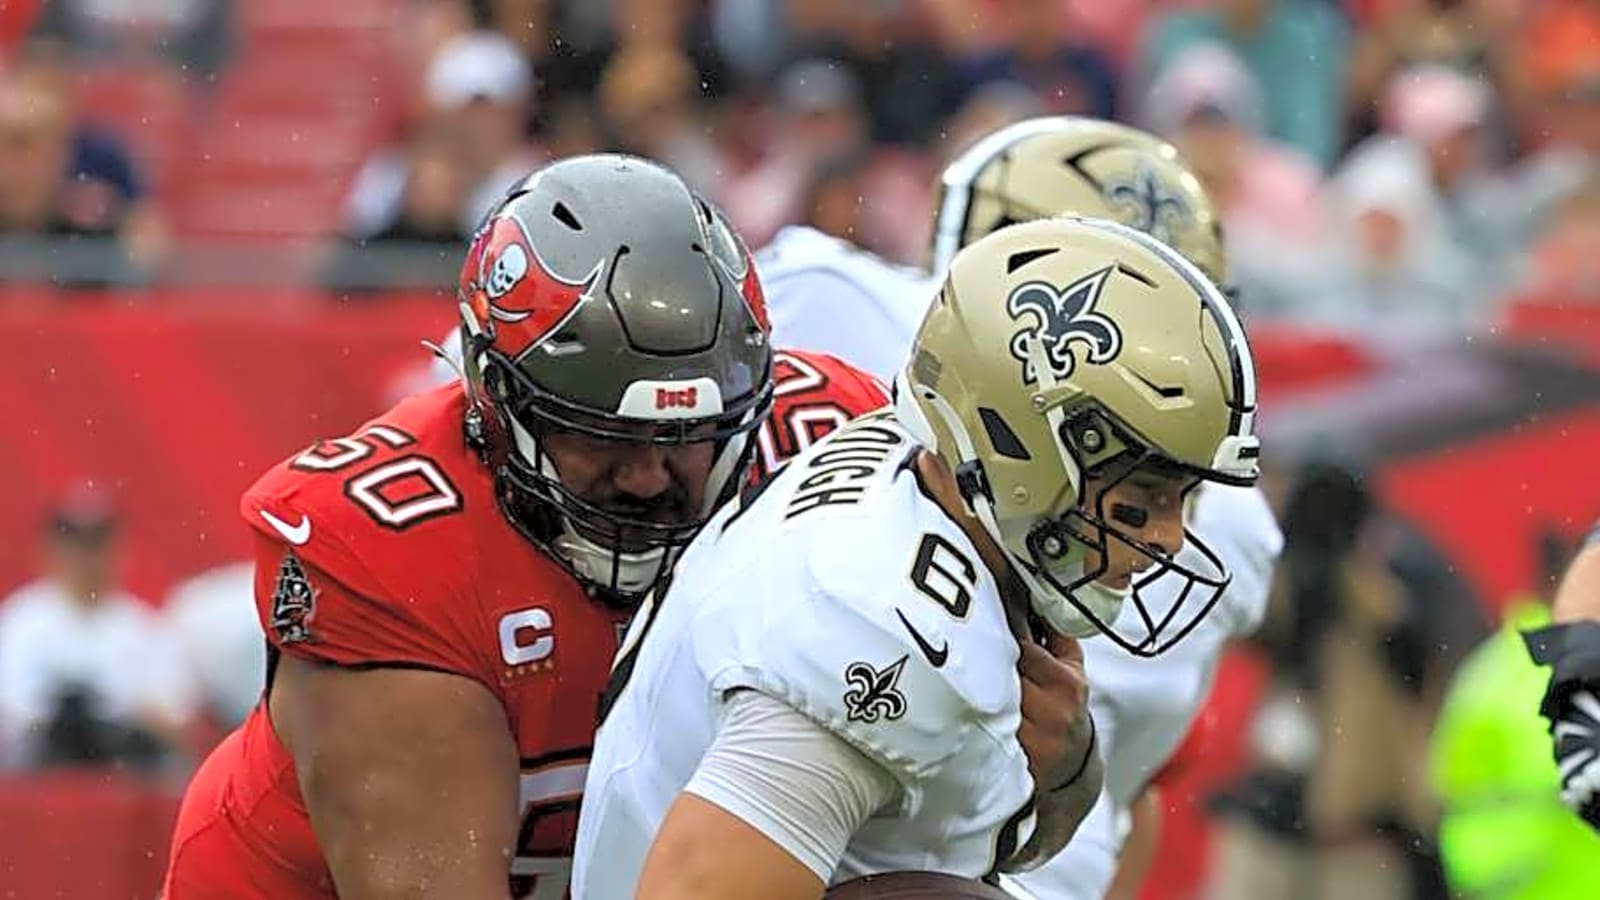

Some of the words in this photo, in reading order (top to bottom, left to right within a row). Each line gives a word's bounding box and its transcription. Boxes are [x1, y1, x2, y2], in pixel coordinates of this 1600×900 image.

[290, 424, 465, 532] 50
[785, 411, 902, 520] OUGH
[909, 531, 978, 619] 6
[498, 605, 555, 667] C
